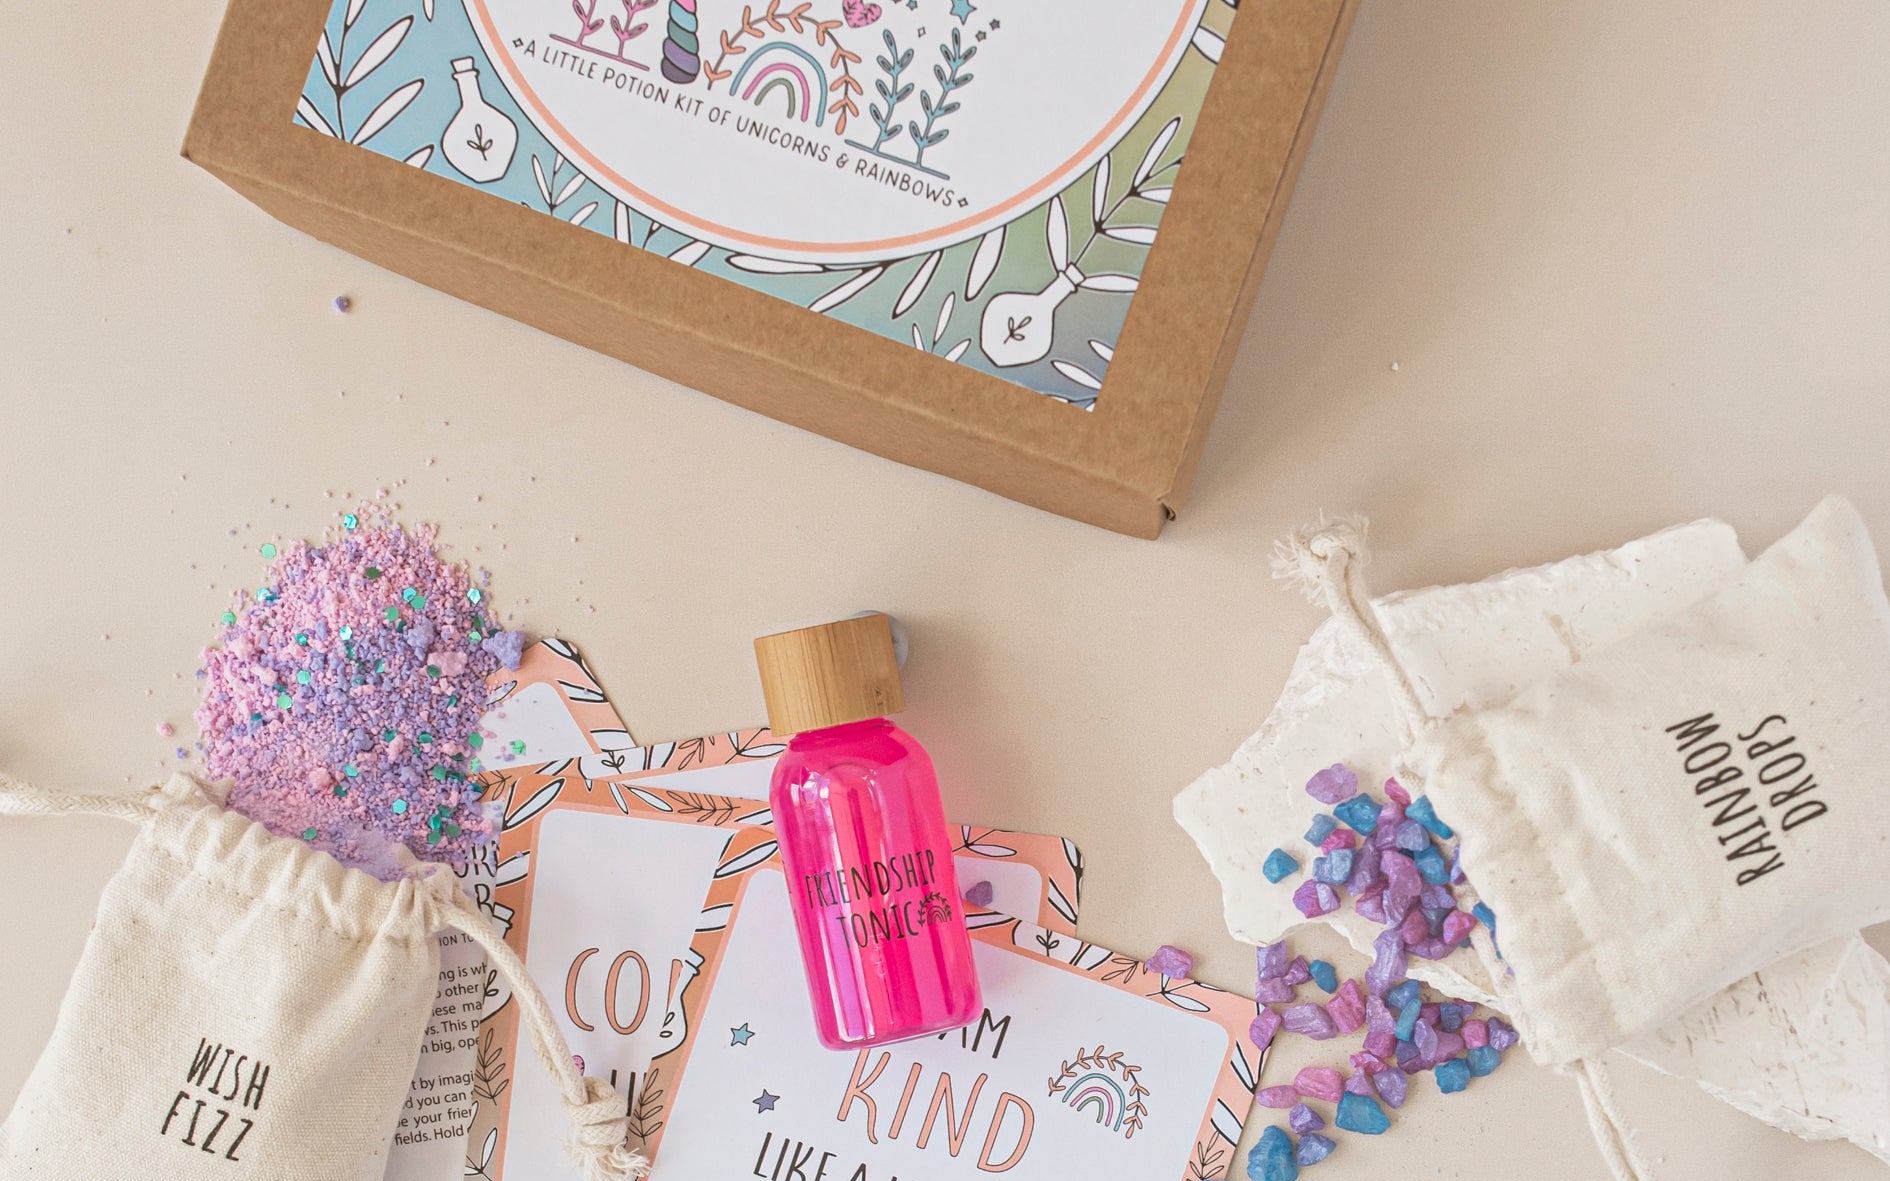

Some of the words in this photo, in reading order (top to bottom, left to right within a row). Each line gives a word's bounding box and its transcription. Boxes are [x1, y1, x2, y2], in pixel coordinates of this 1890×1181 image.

[524, 40, 536, 56] A
[543, 47, 598, 81] LITTLE
[603, 67, 668, 106] POTION
[674, 93, 704, 118] KIT
[708, 105, 730, 127] OF
[737, 113, 832, 164] UNICORNS
[836, 153, 849, 169] &
[855, 157, 957, 209] RAINBOWS
[1737, 714, 1828, 832] DROPS
[1665, 712, 1785, 886] RAINBOW
[805, 849, 935, 910] FRIENDSHIP
[836, 901, 919, 950] TONIC
[439, 970, 455, 982] ng
[458, 966, 468, 978] is
[444, 983, 480, 997] other
[463, 1001, 483, 1013] ma
[440, 1019, 468, 1033] This
[431, 1040, 456, 1054] big,
[186, 1037, 270, 1110] WISH
[420, 1077, 435, 1091] by
[439, 1070, 474, 1086] imagi
[416, 1094, 441, 1110] you
[444, 1091, 467, 1103] can
[837, 1049, 1035, 1173] KIND
[161, 1090, 253, 1161] FIZZ
[413, 1112, 443, 1128] your
[395, 1130, 432, 1146] fields.
[433, 1123, 464, 1140] Hold
